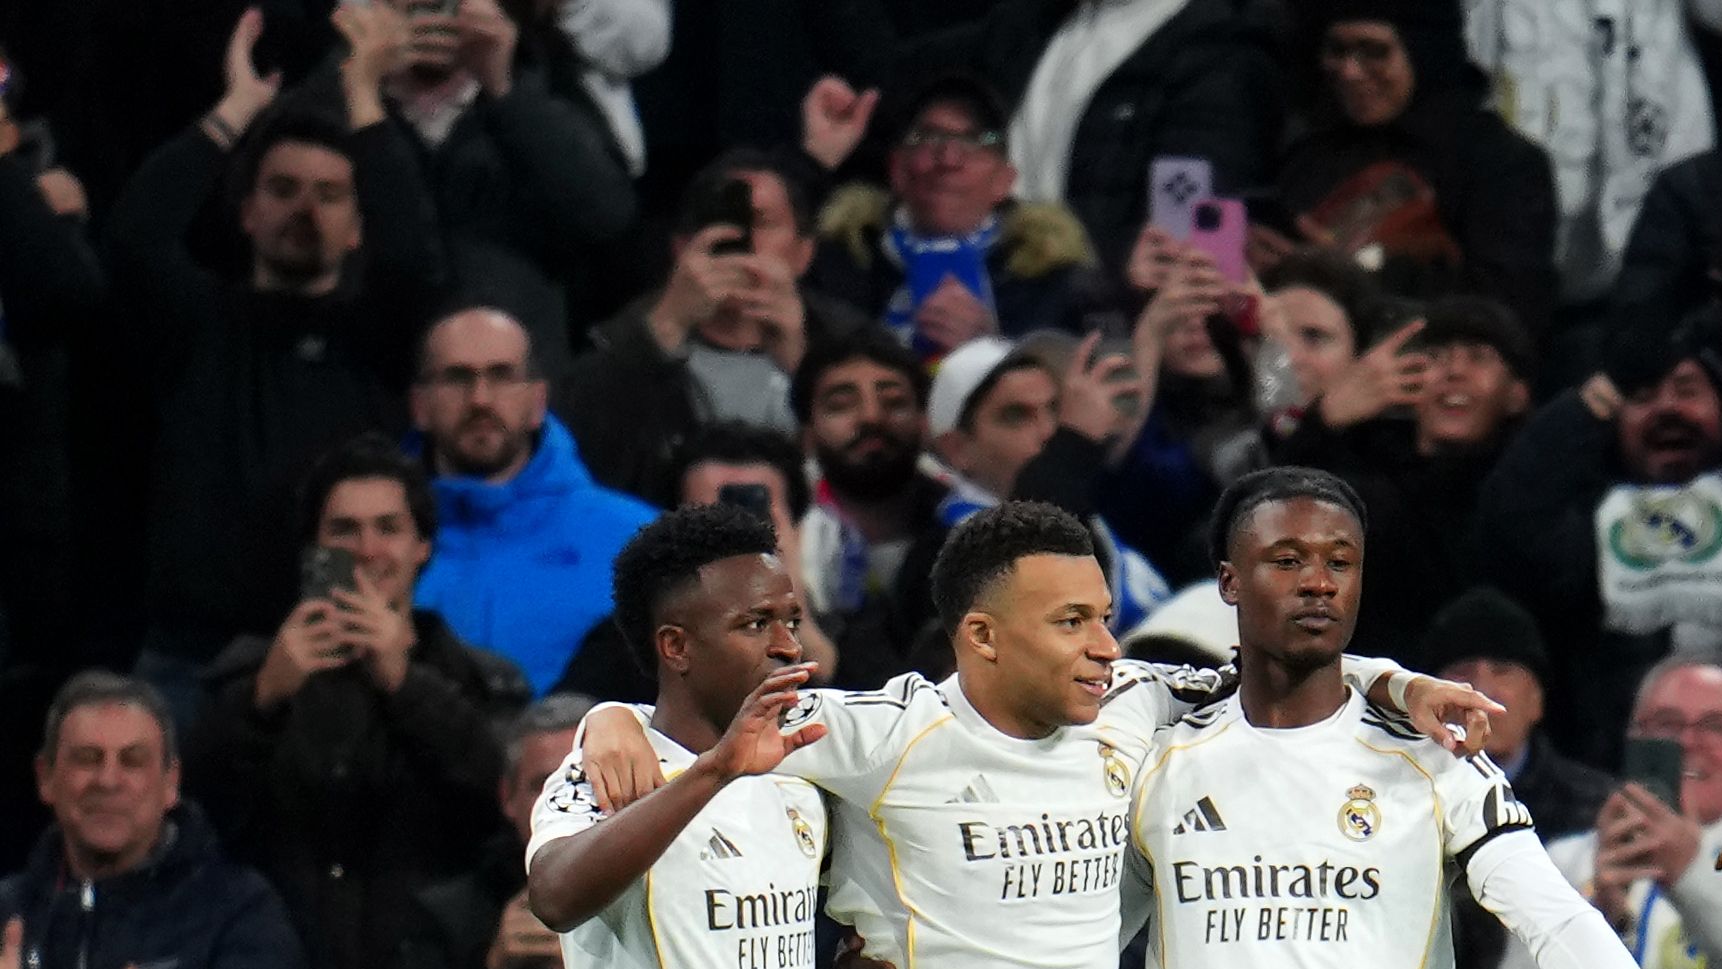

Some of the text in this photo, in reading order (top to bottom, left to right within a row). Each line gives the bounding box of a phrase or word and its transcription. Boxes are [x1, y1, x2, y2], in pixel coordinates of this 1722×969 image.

[1001, 852, 1118, 900] FLY BETTER
[1172, 854, 1380, 904] Emirates
[704, 883, 817, 931] Emirat
[1205, 906, 1348, 944] FLY BETTER
